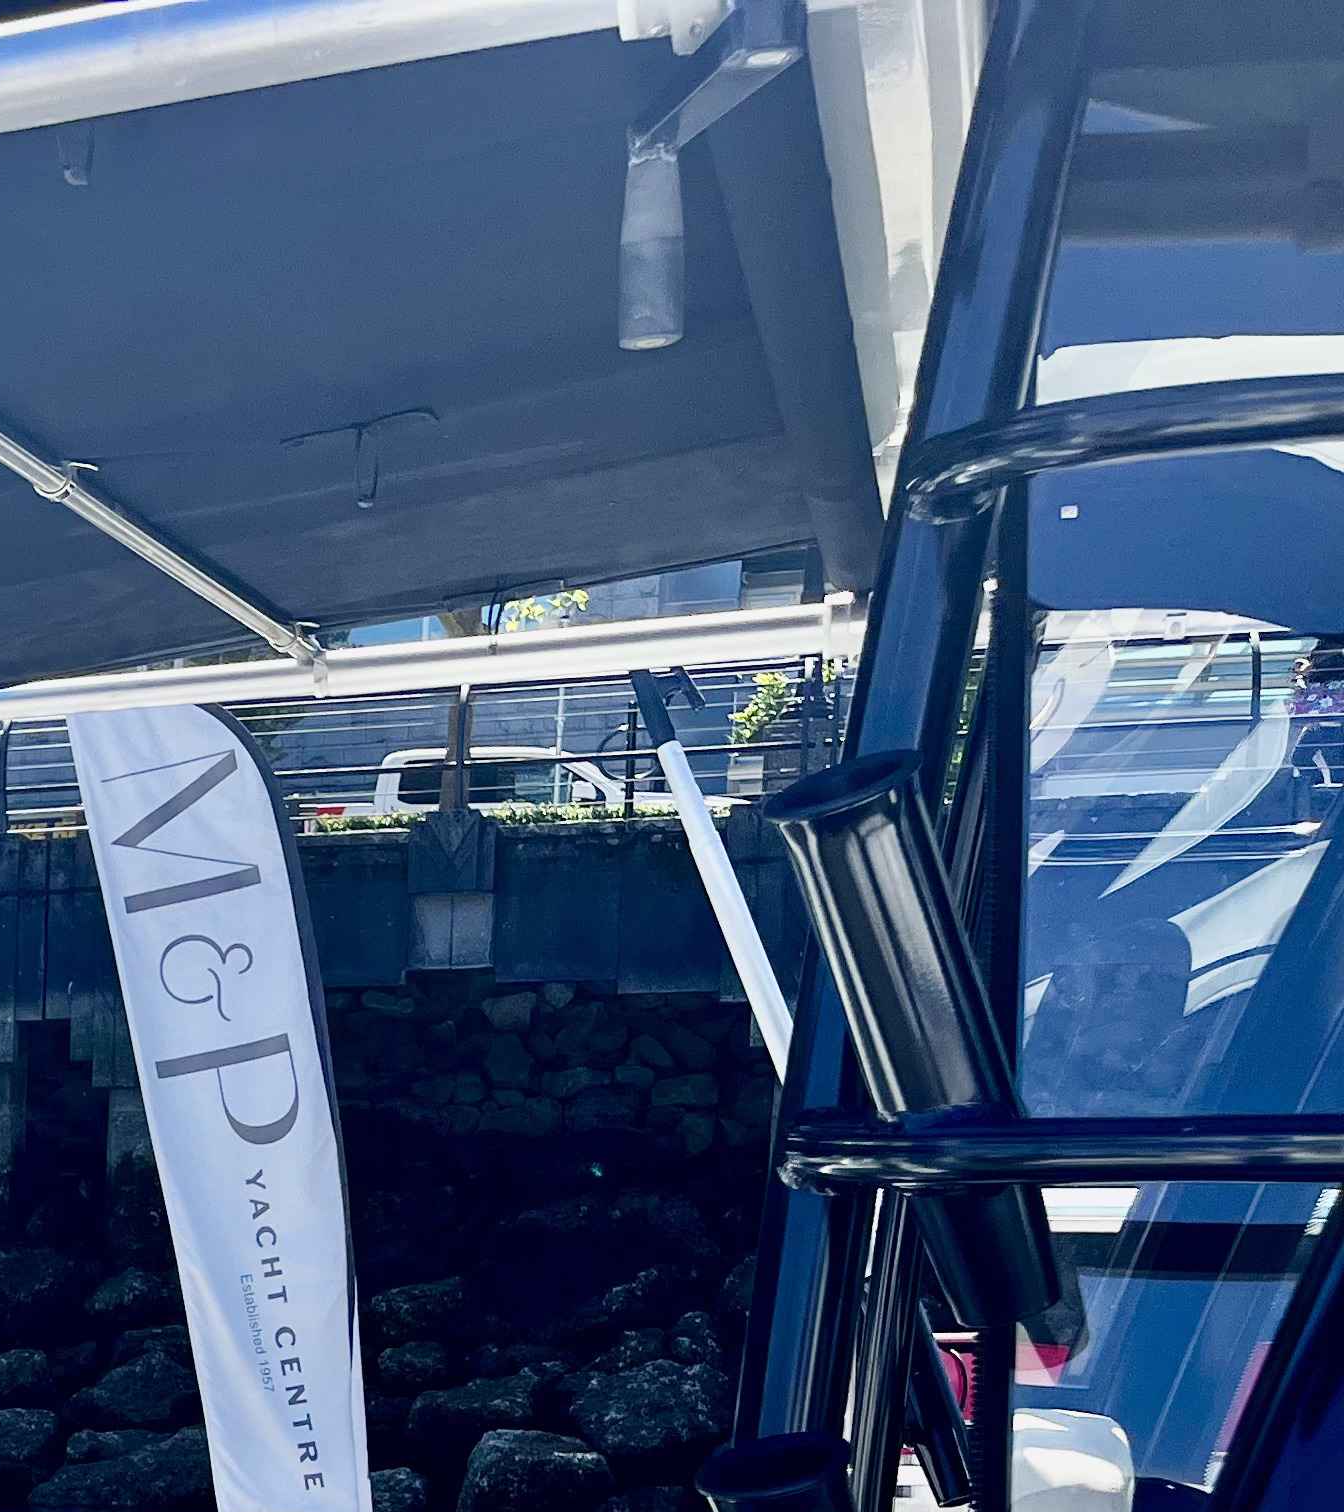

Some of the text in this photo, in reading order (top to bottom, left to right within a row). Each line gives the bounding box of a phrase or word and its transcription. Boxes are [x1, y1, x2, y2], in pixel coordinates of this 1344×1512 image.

[240, 1273, 275, 1393] Established 1957
[245, 1168, 324, 1491] YACHT CENTRE
